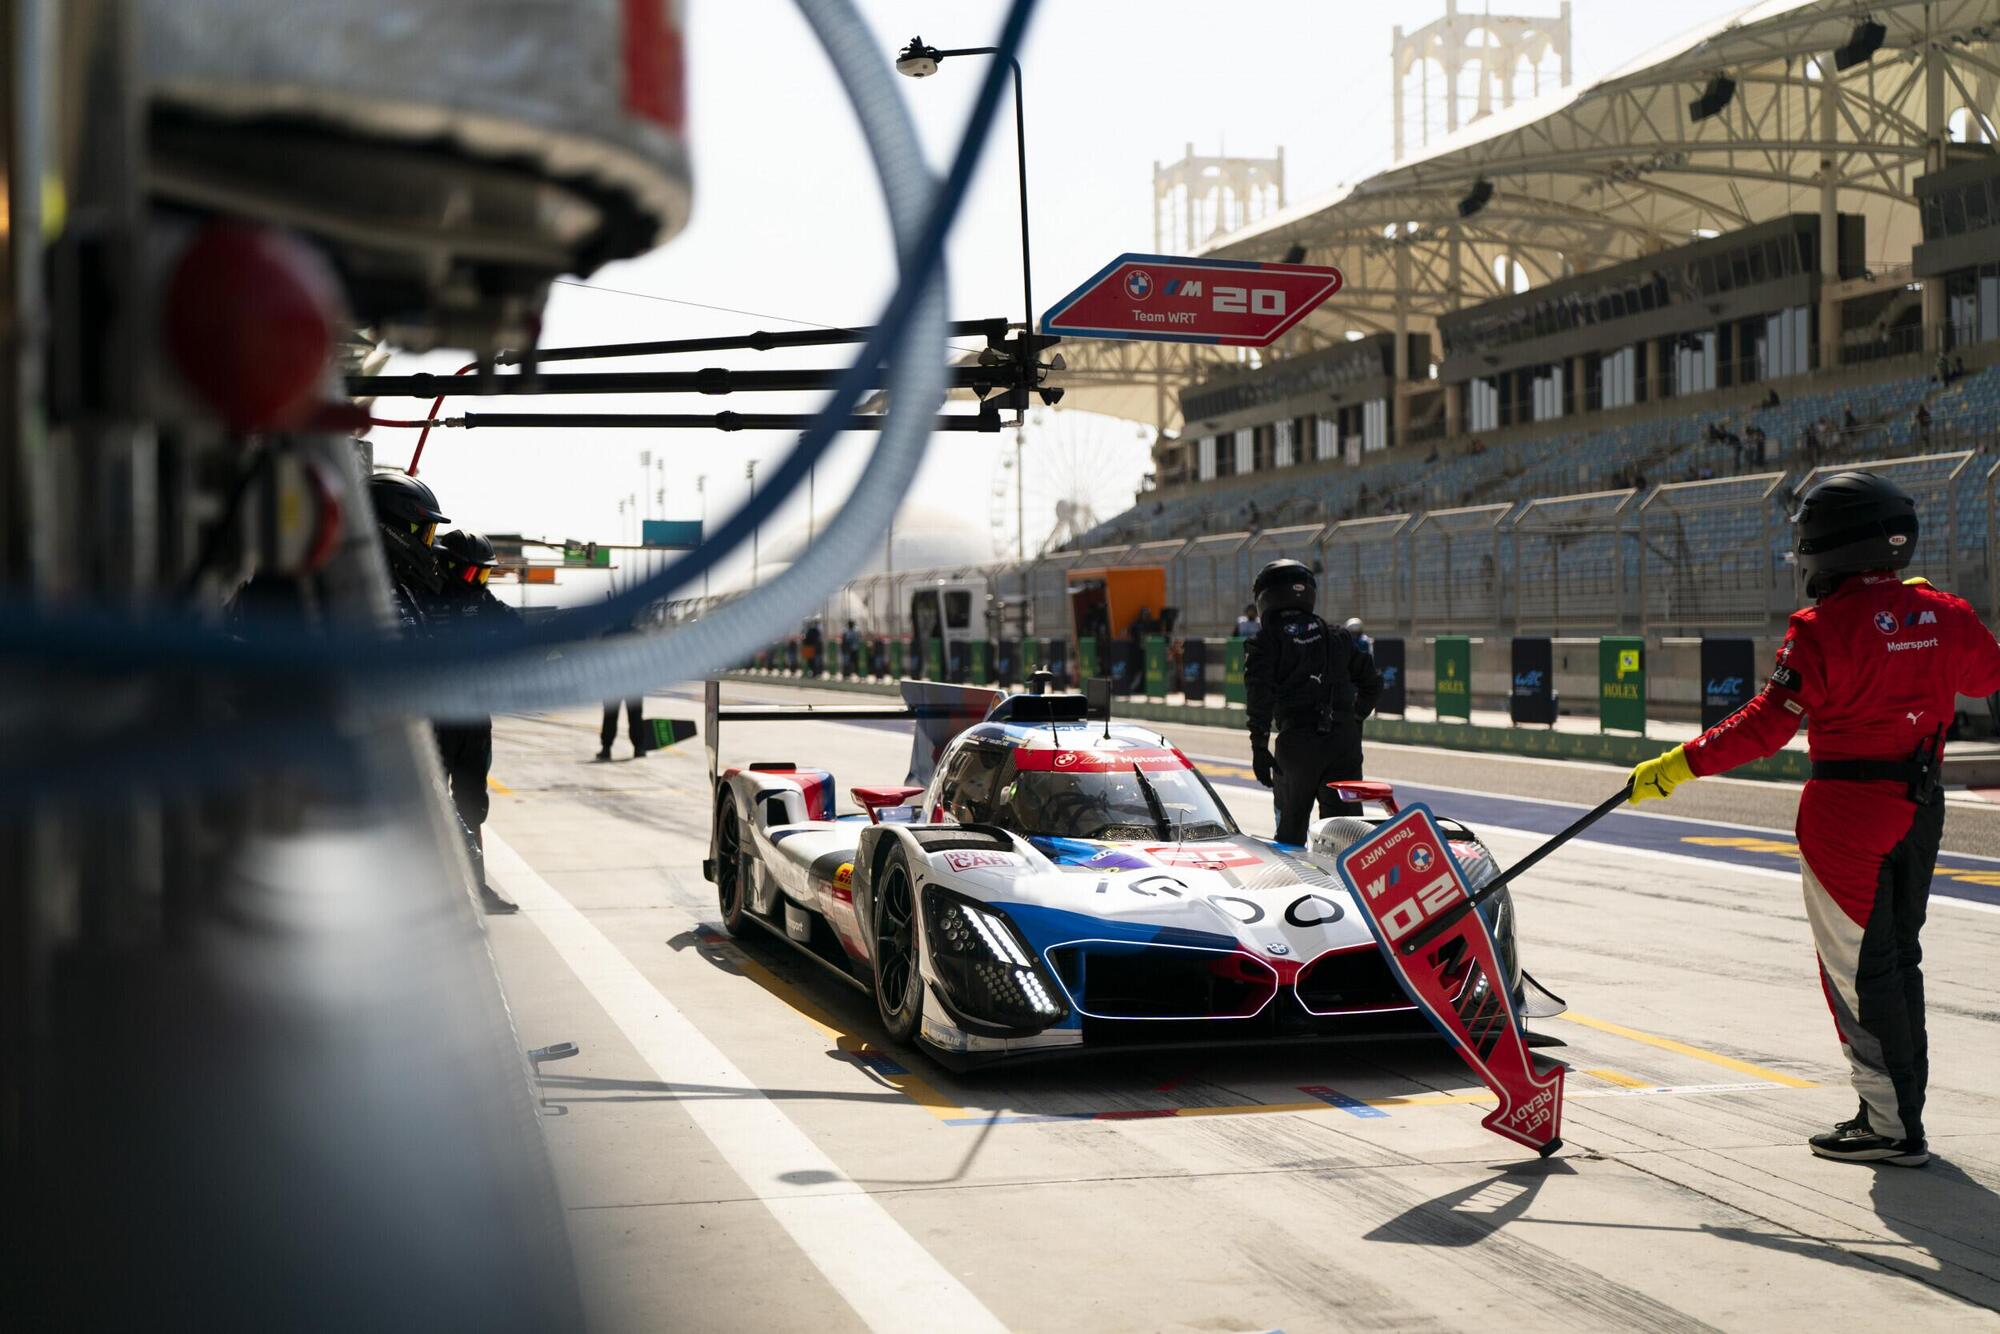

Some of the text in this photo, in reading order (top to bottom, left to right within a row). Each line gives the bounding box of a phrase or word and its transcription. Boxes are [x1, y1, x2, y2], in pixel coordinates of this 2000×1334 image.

[1212, 286, 1286, 316] 20
[1132, 309, 1198, 324] Team WRT
[1918, 610, 1938, 625] M
[1887, 637, 1939, 652] Motorsport
[1604, 683, 1638, 699] ROLEX
[1360, 827, 1416, 871] Team WRT
[953, 857, 1008, 868] CAR
[1380, 871, 1461, 942] 20
[1509, 1088, 1553, 1128] READY
[1525, 1107, 1551, 1134] GET
